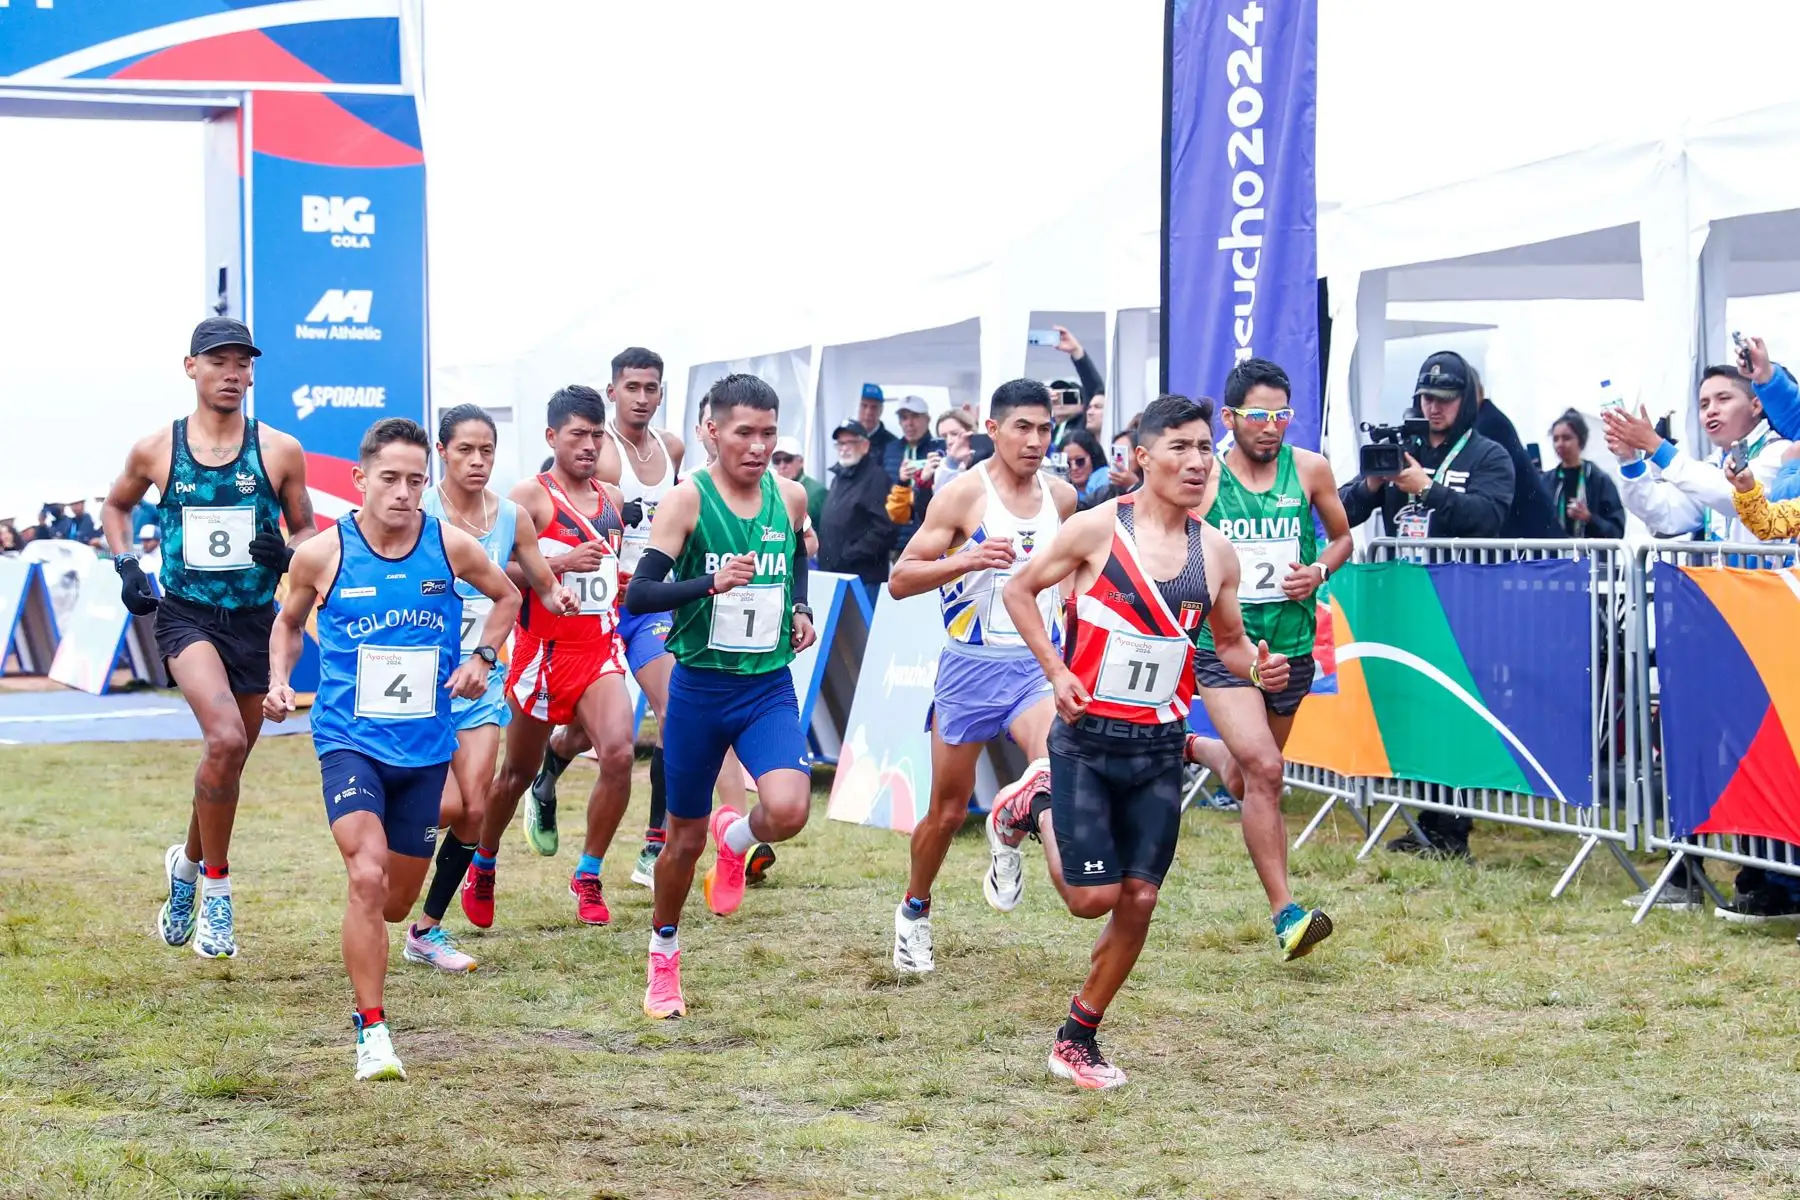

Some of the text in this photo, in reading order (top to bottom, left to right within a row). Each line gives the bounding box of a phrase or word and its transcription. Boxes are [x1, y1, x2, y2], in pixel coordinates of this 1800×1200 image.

[302, 195, 375, 234] BIG
[331, 235, 371, 248] COLA
[295, 324, 382, 340] New Athletic
[311, 386, 385, 408] SPORADE
[175, 482, 196, 494] PAN
[1220, 517, 1301, 539] BOLIVIA
[208, 530, 231, 557] 8
[1255, 562, 1275, 590] 2
[576, 577, 608, 602] 10
[346, 608, 445, 639] COLOMBIA
[461, 617, 476, 641] 7
[743, 609, 756, 638] 1
[1115, 636, 1153, 649] Ayacucho
[366, 653, 402, 661] Ayacucho
[1128, 660, 1160, 692] 11
[384, 673, 412, 704] 4
